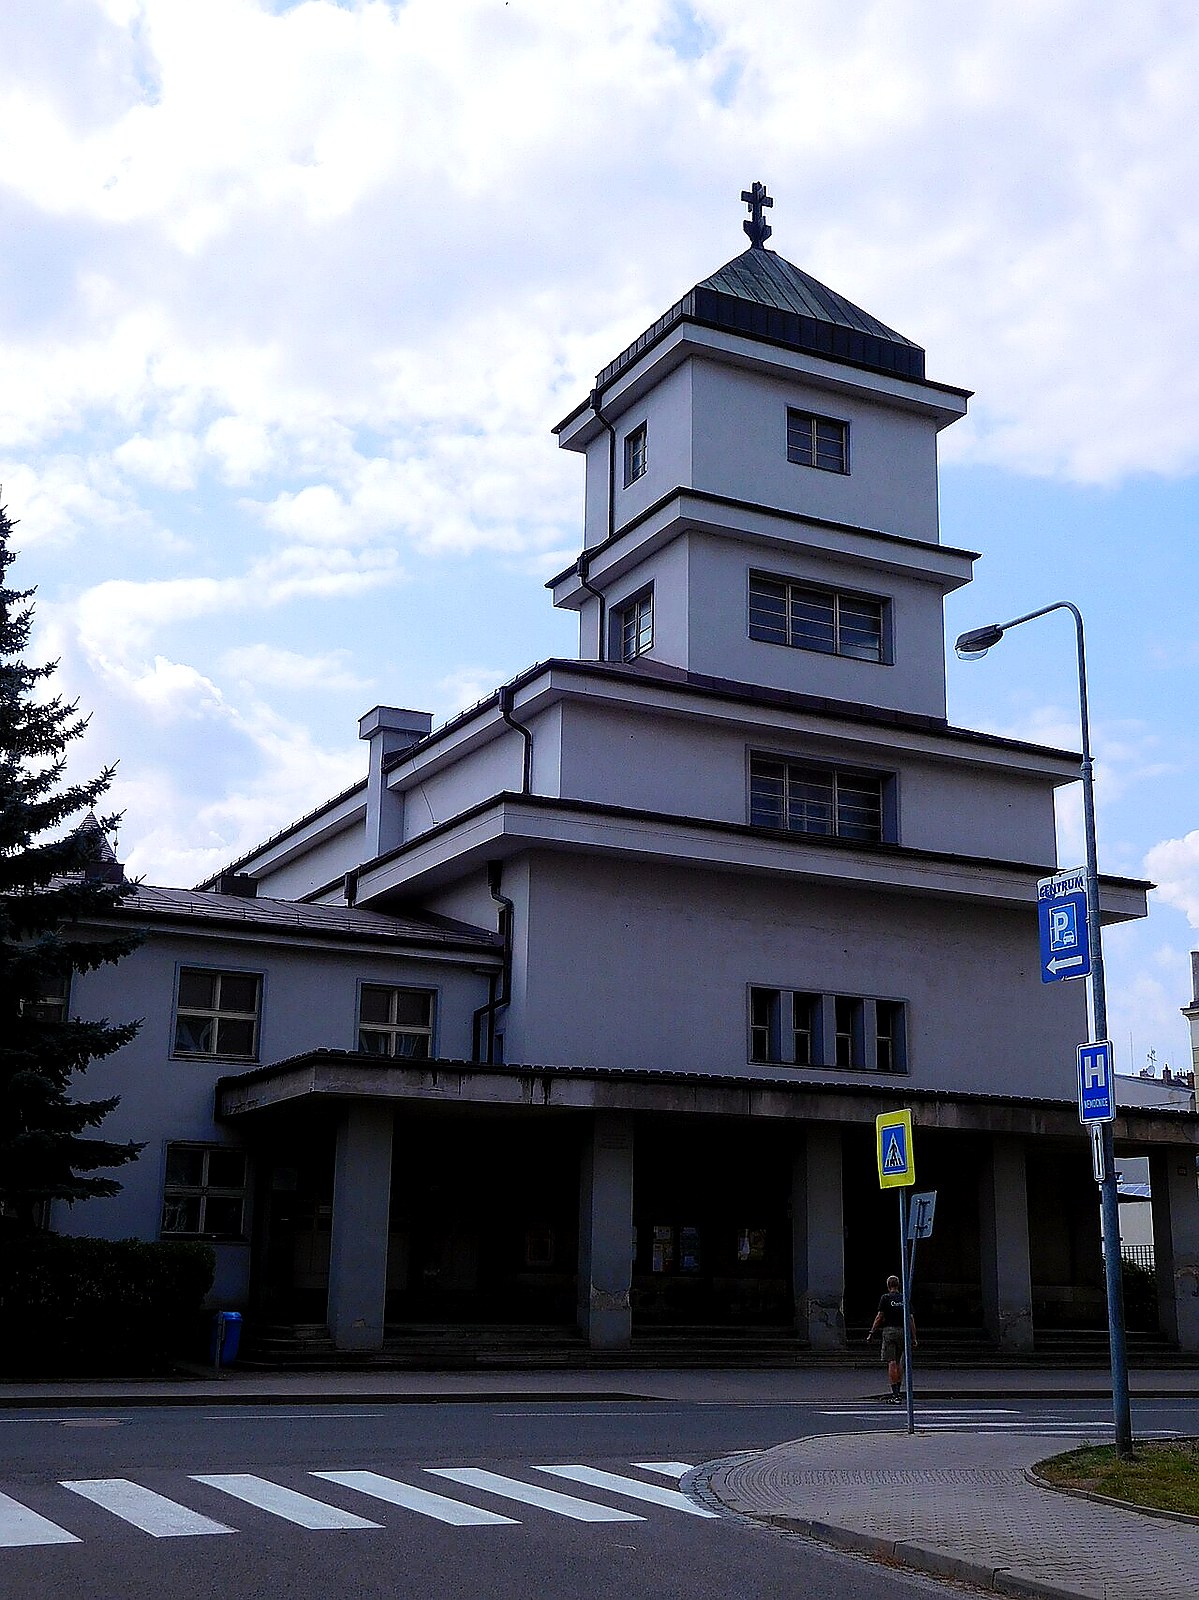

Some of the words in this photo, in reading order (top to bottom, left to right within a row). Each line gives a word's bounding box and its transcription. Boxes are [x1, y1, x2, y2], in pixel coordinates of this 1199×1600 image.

[1040, 876, 1083, 897] CENTRUM
[1054, 911, 1068, 941] P
[1084, 1054, 1105, 1088] H
